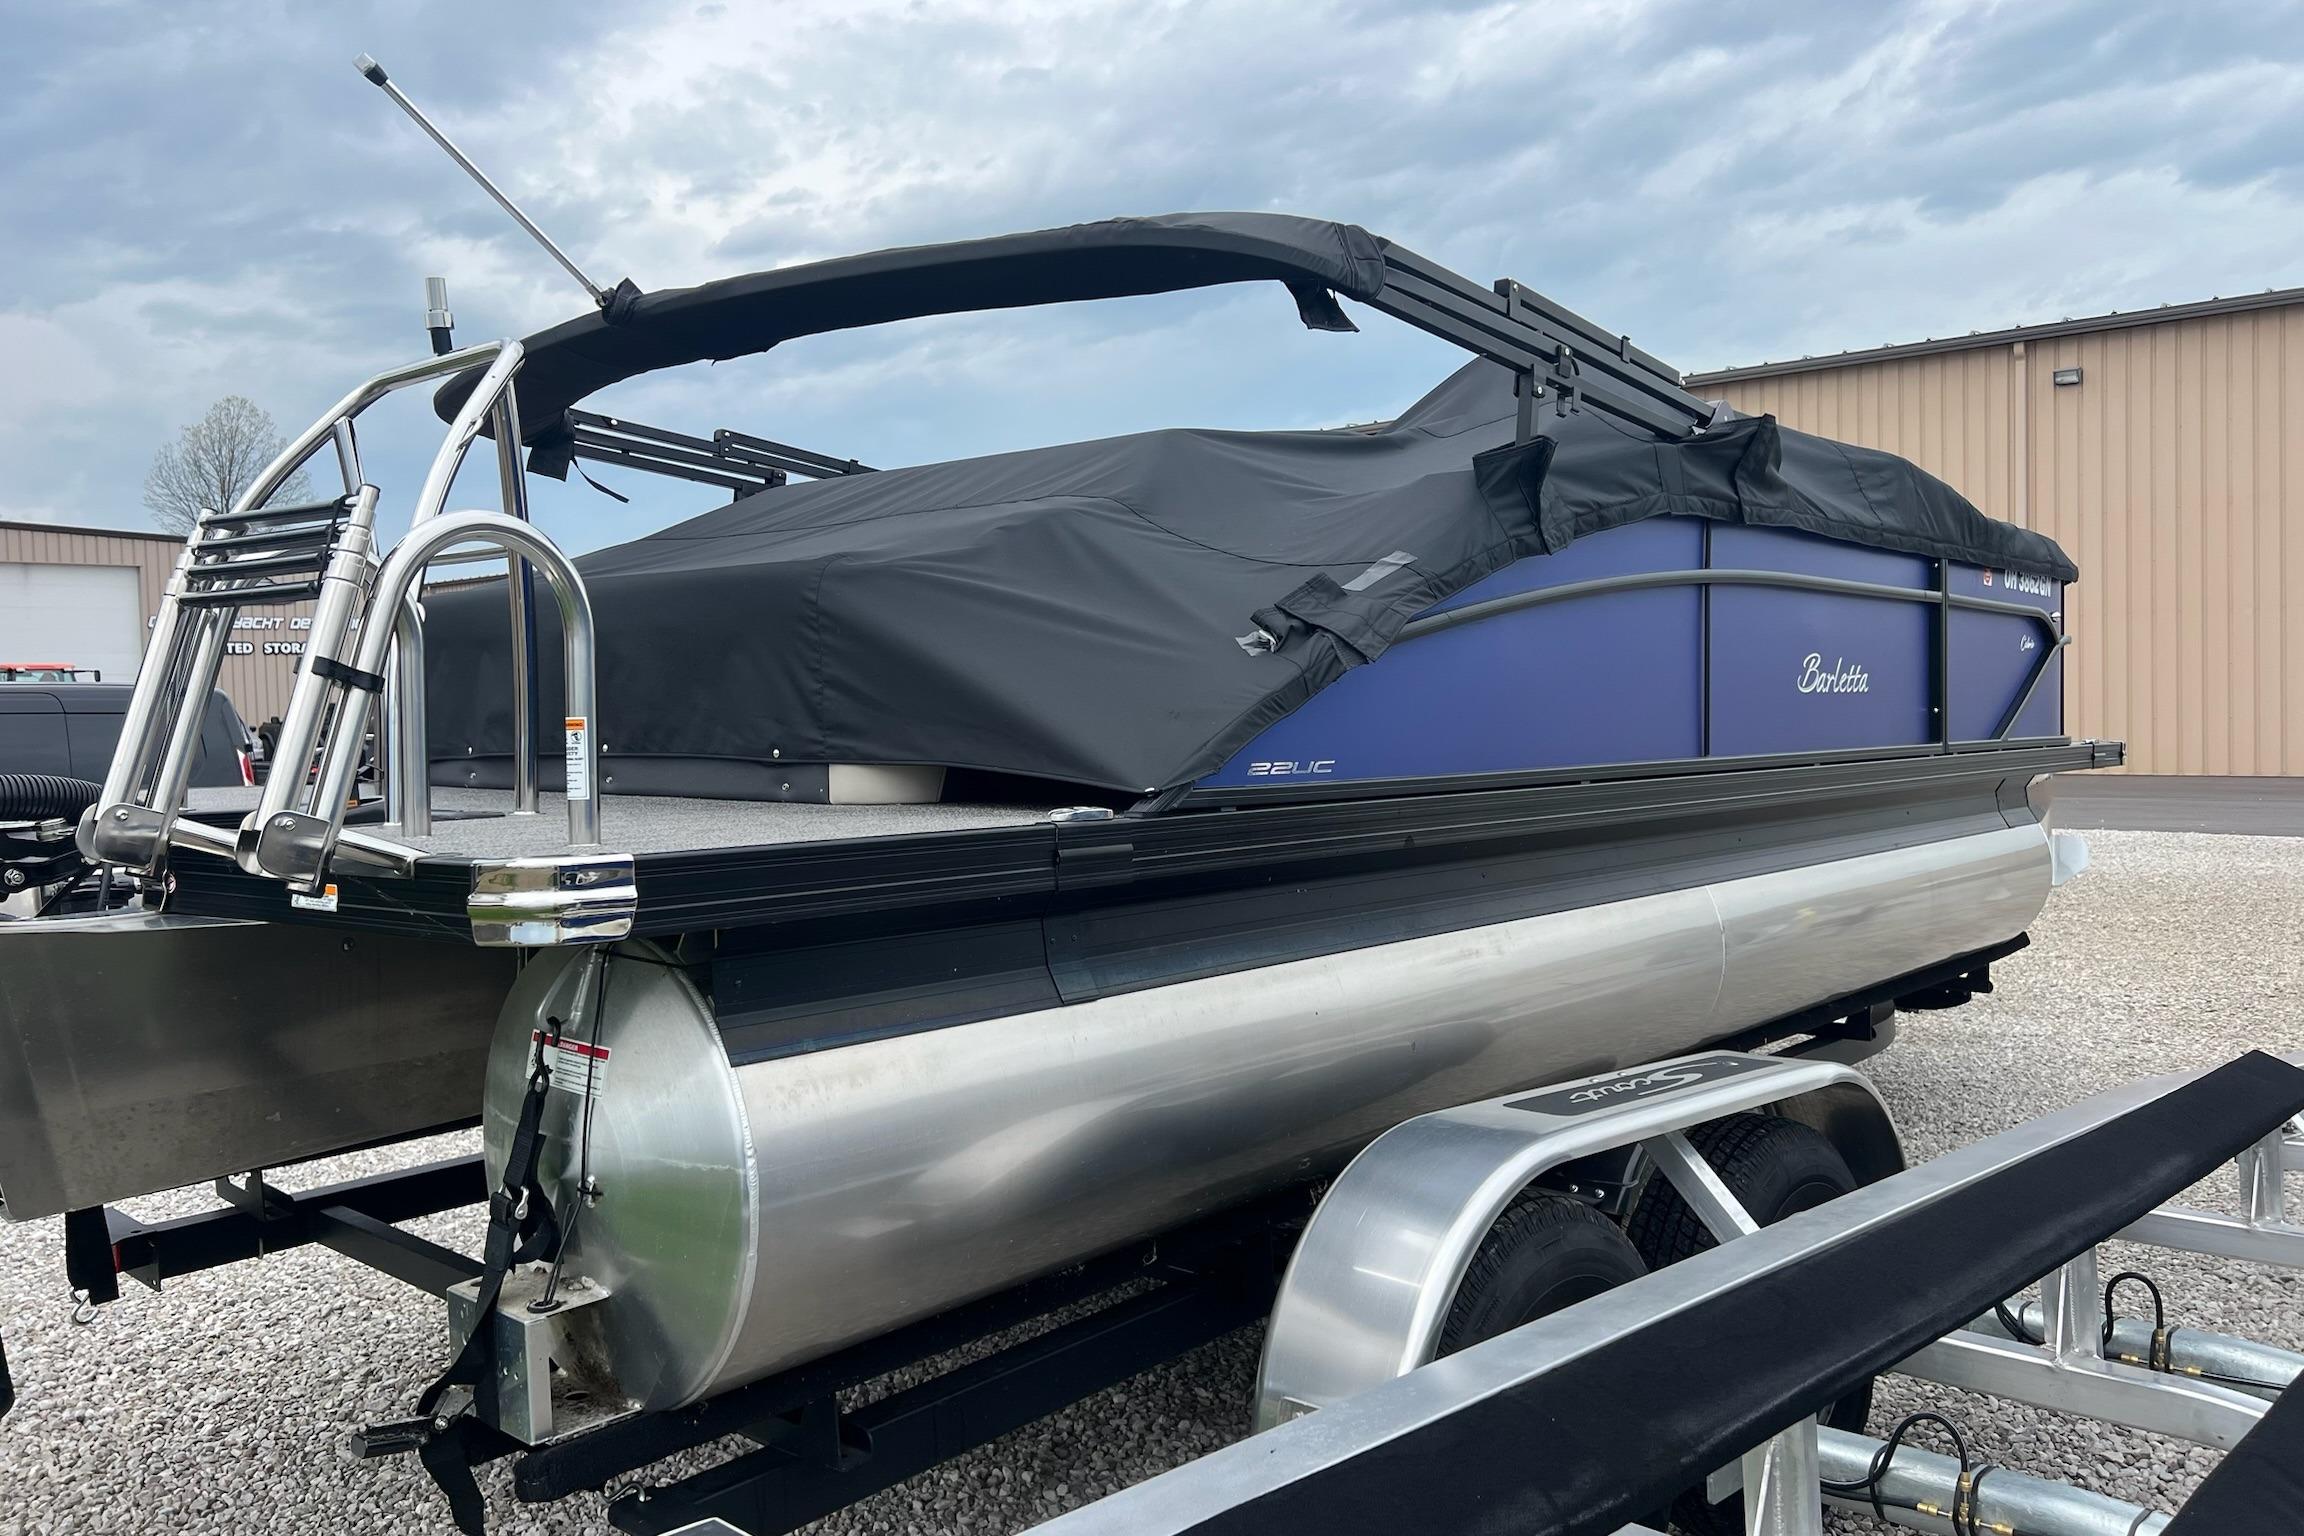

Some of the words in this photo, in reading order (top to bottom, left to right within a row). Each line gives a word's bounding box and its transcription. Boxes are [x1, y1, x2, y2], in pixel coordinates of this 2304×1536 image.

[226, 641, 255, 655] TED
[1797, 652, 1869, 693] Barletta
[1247, 760, 1336, 776] 22UC
[1569, 1060, 1718, 1104] Scout
